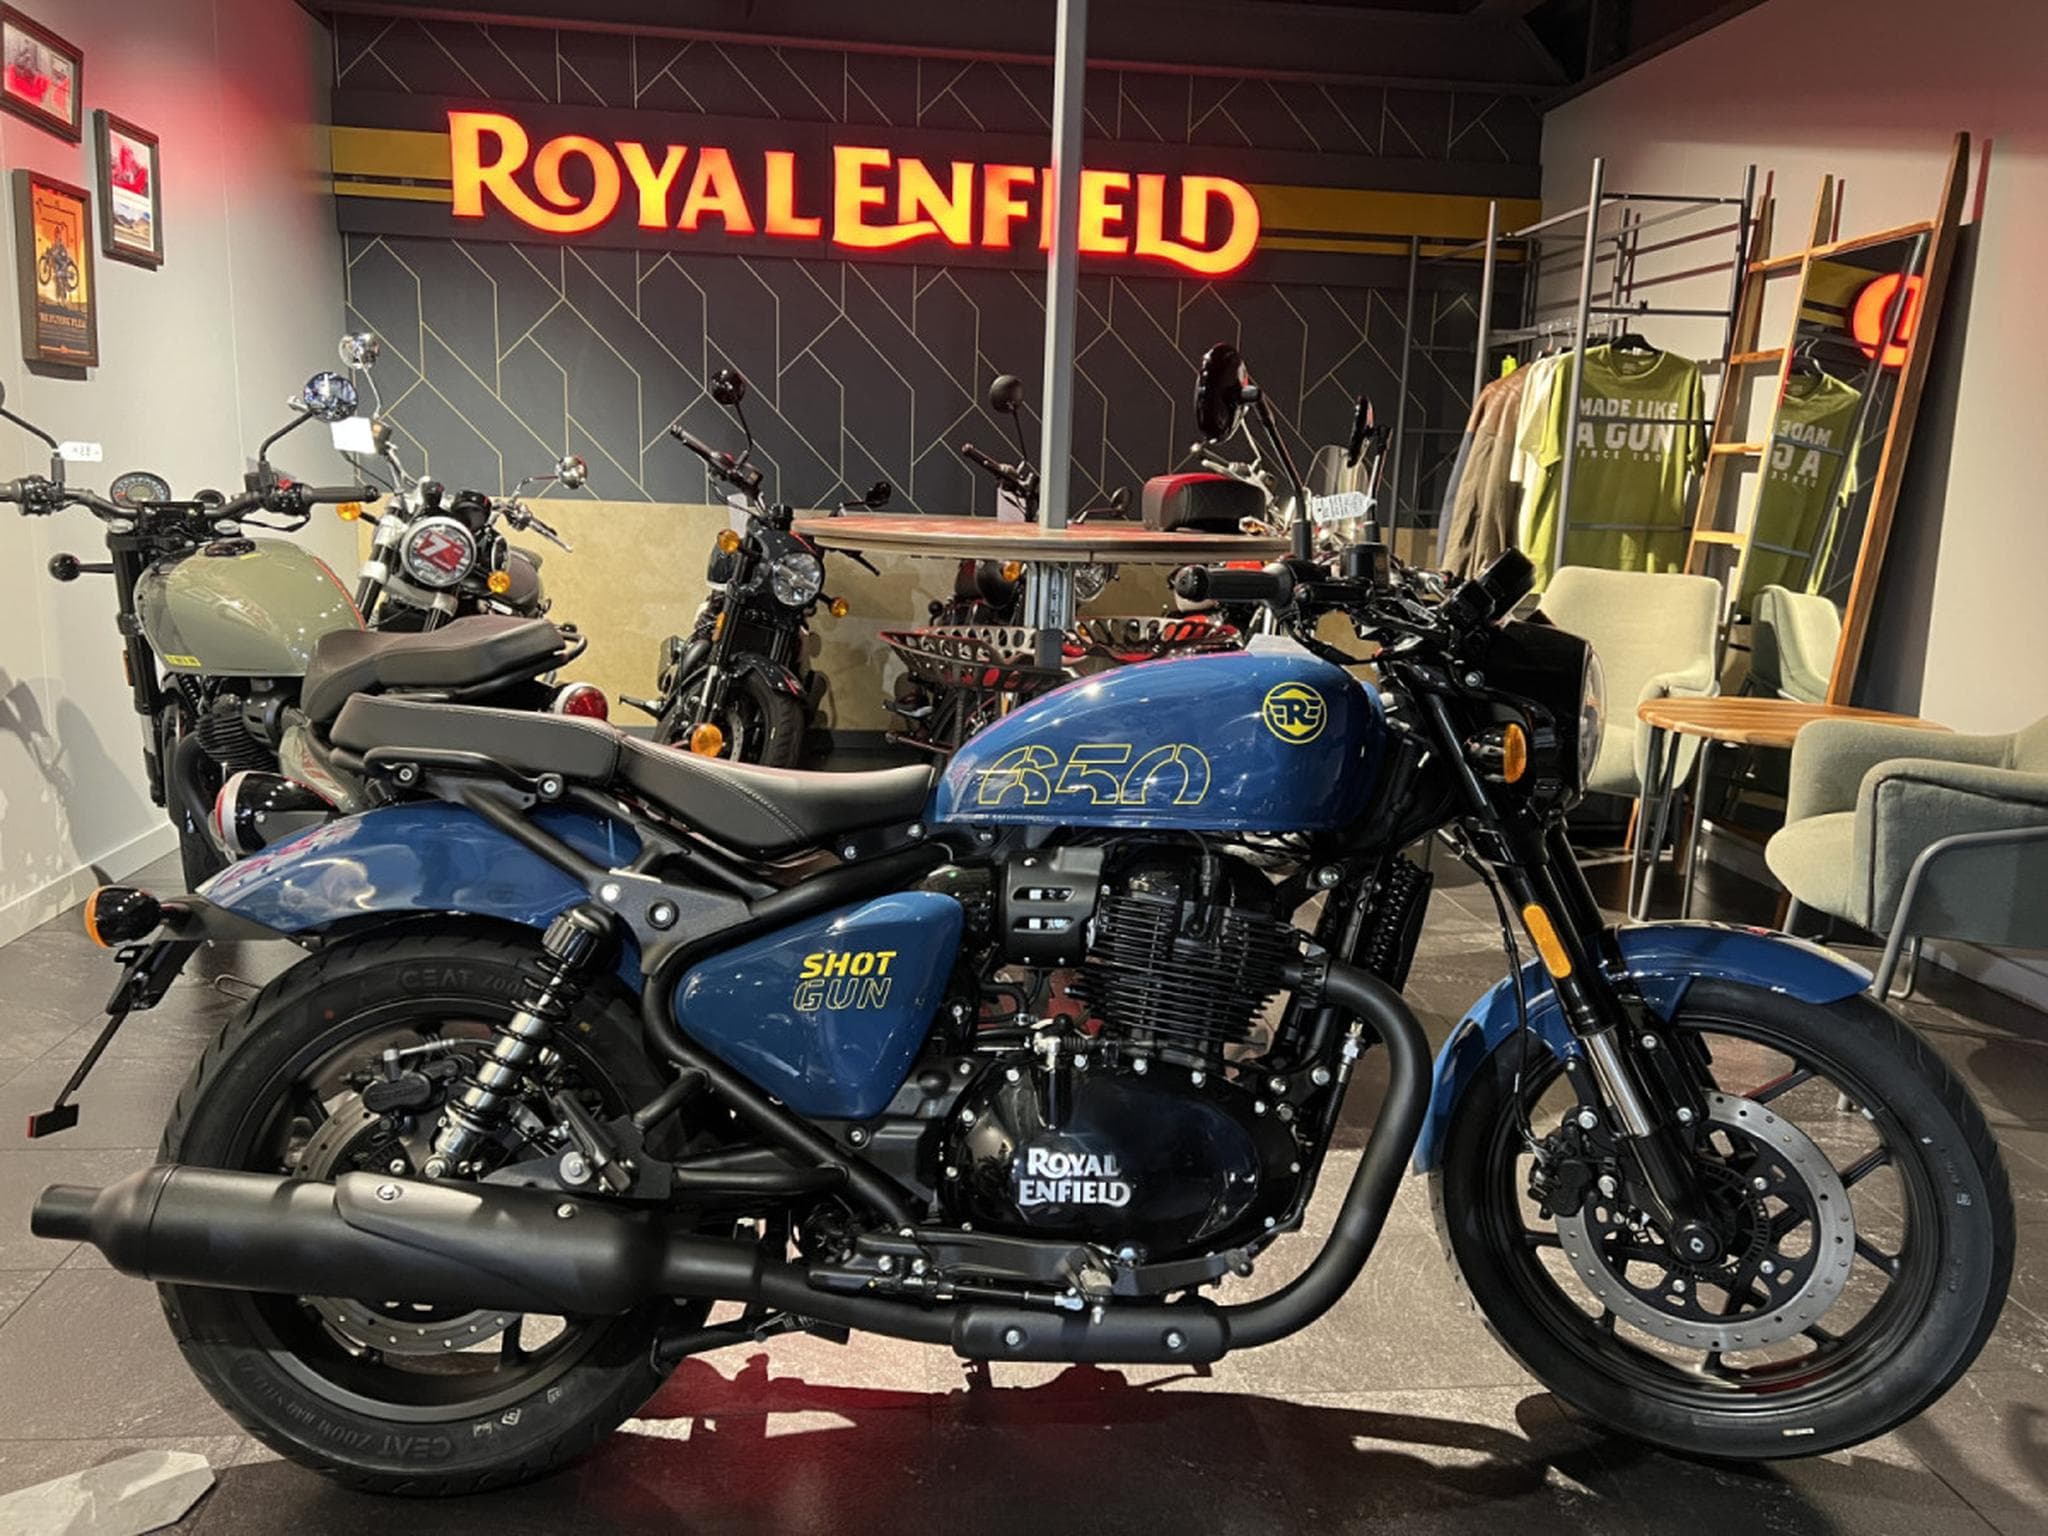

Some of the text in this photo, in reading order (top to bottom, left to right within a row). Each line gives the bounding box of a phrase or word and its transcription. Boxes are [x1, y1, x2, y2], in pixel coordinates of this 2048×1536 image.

[447, 111, 822, 233] ROYAL
[1579, 397, 1679, 420] MADE LIKE
[1576, 422, 1675, 453] A GUN
[1579, 450, 1620, 460] INCE
[978, 744, 1212, 805] 650
[401, 968, 475, 989] CEAT
[799, 950, 897, 979] SHOT
[793, 977, 892, 1011] GUN
[1027, 1147, 1121, 1179] ROYAL
[1018, 1180, 1131, 1208] ENFIELD
[376, 1434, 453, 1459] CEAT
